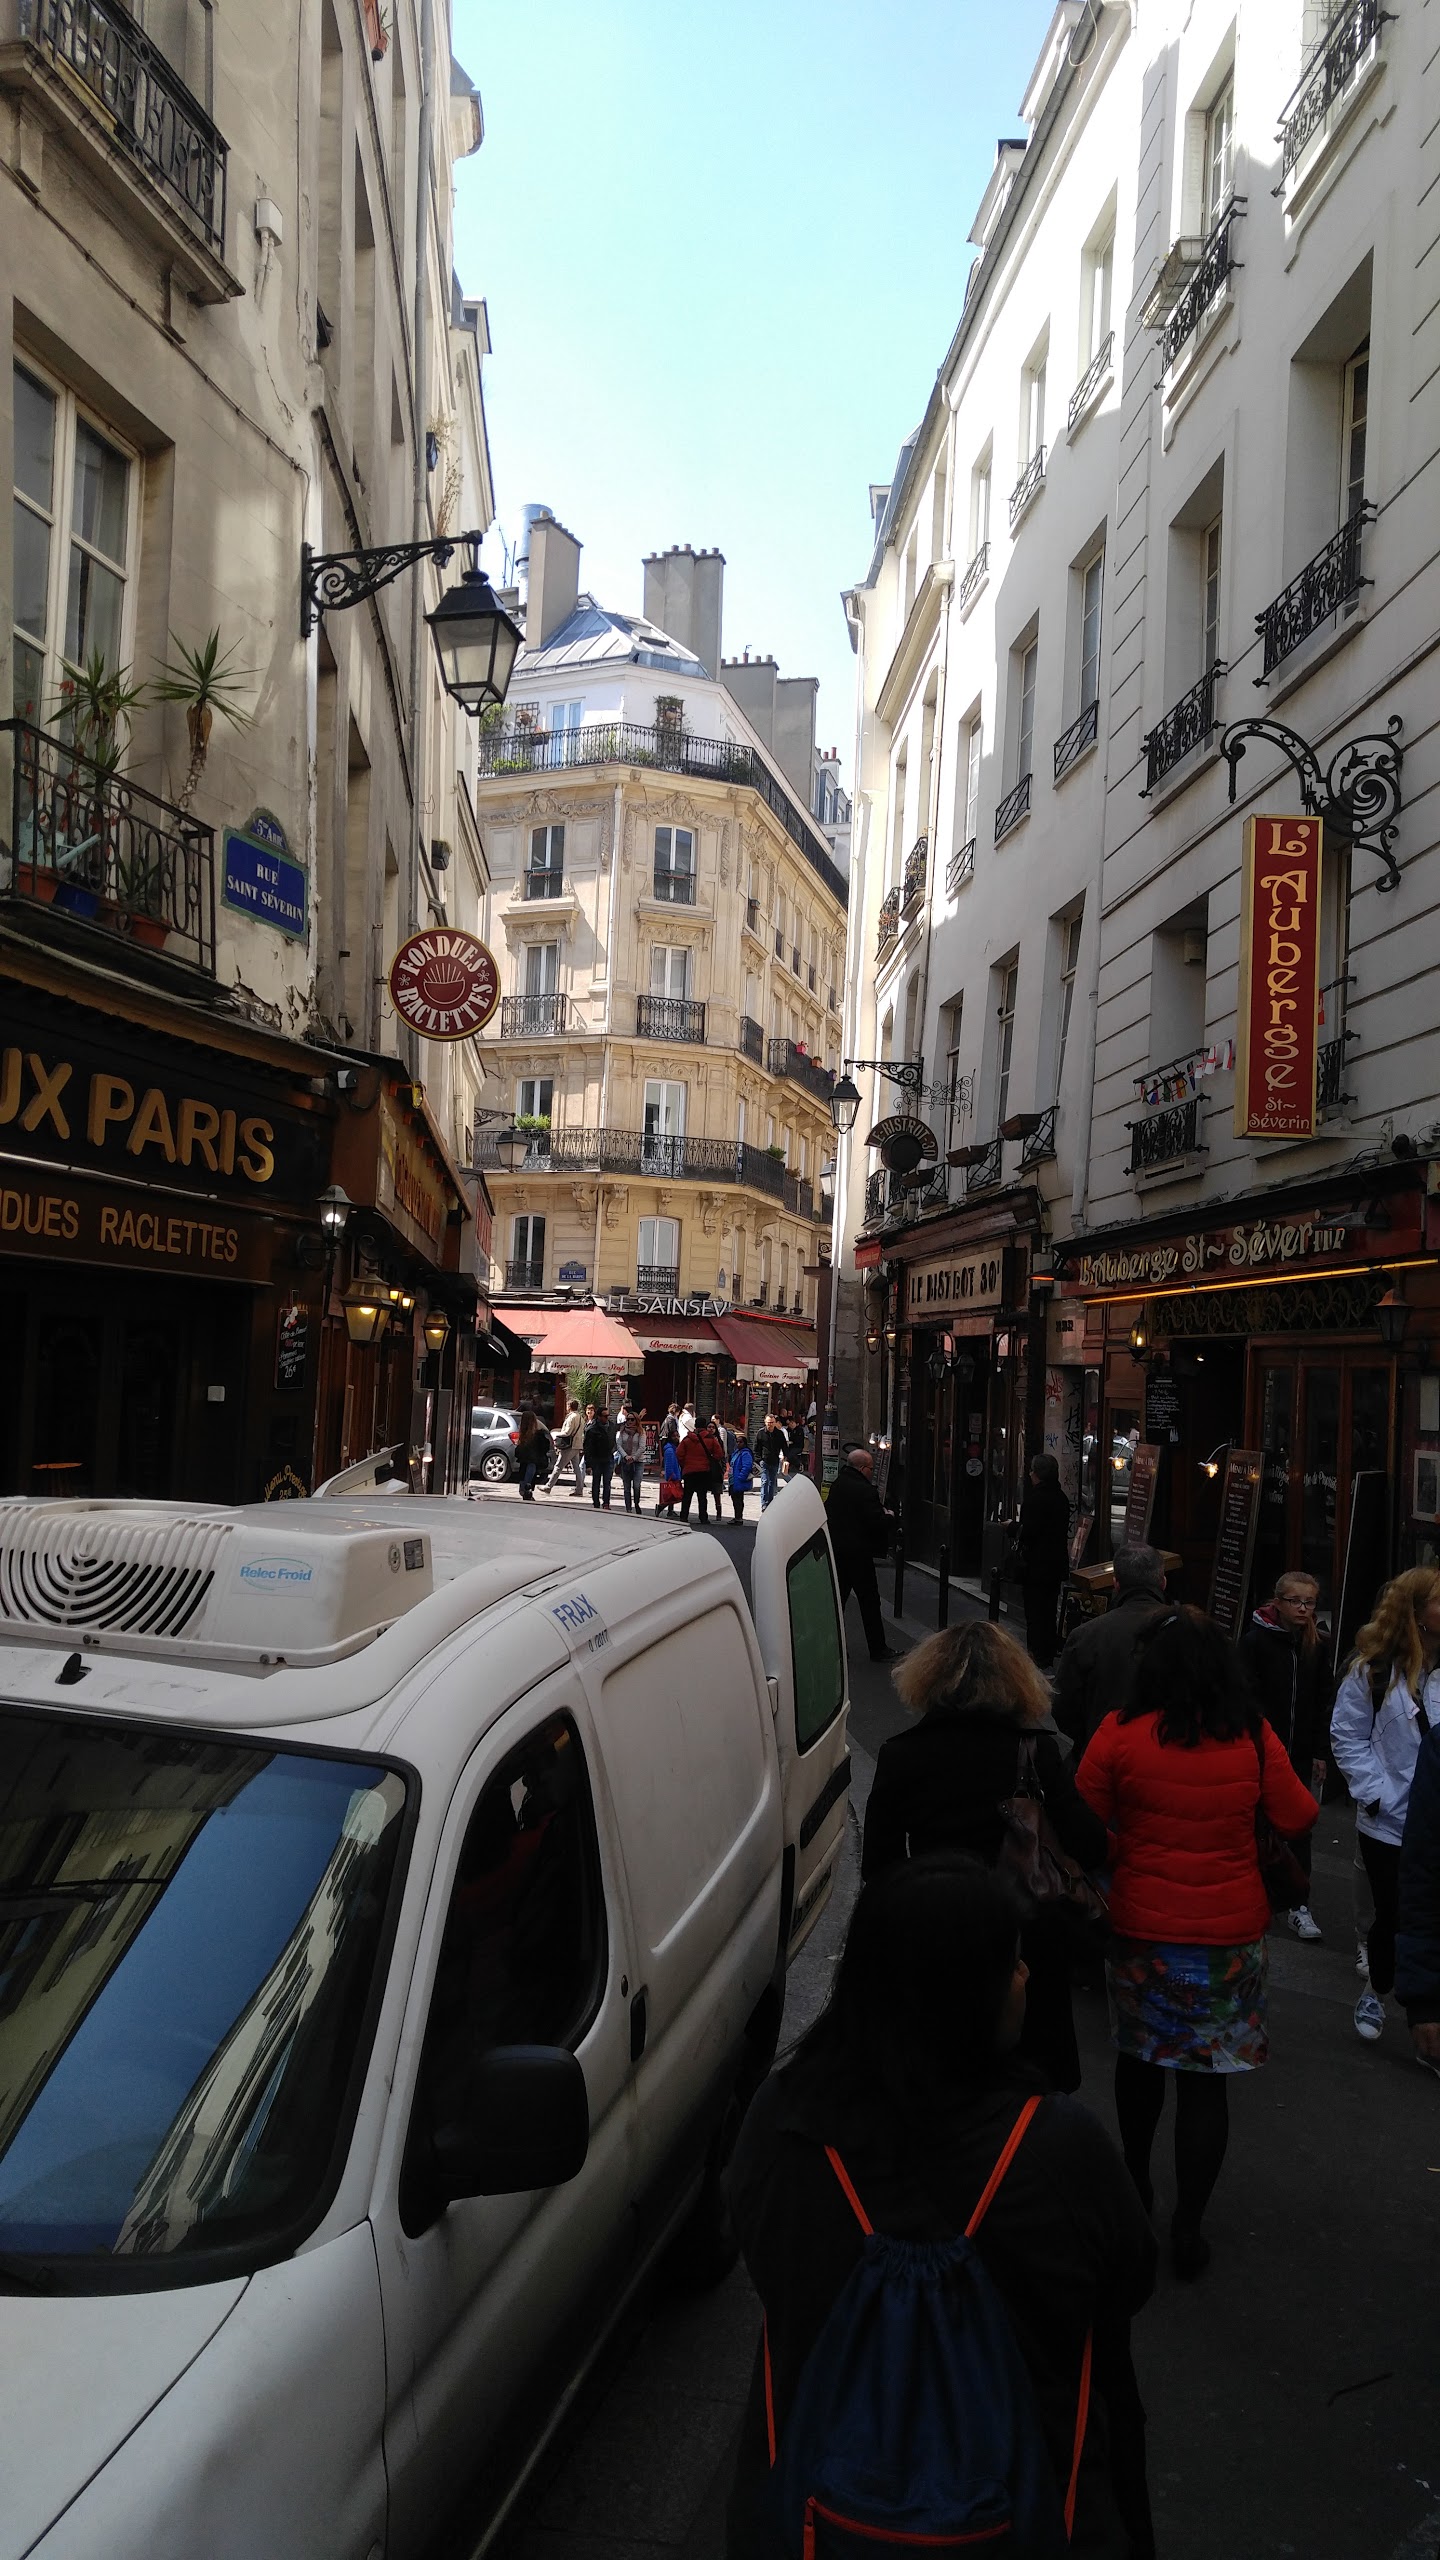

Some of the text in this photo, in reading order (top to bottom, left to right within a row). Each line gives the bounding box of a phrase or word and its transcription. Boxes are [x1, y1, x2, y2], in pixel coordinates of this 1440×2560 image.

[256, 863, 279, 886] RUE
[227, 874, 304, 921] SAINT SÉVERIN
[398, 935, 489, 977] FONDUES
[396, 982, 494, 1032] RACLETTES
[87, 1073, 275, 1183] PARIS
[1249, 1112, 1311, 1130] Séverin
[0, 1188, 239, 1263] DUES RACLETTES
[1078, 1246, 1177, 1289] L'Auberge
[1229, 1209, 1346, 1267] Séverin
[911, 1276, 922, 1304] LE
[926, 1265, 976, 1302] BISTROT
[606, 1294, 634, 1314] LE
[649, 1339, 693, 1351] Brasserie
[581, 1362, 599, 1370] Non
[608, 1363, 625, 1374] Stop
[759, 1371, 780, 1379] Cuisine
[239, 1566, 312, 1580] Relec Froid
[552, 1594, 598, 1632] FRAX
